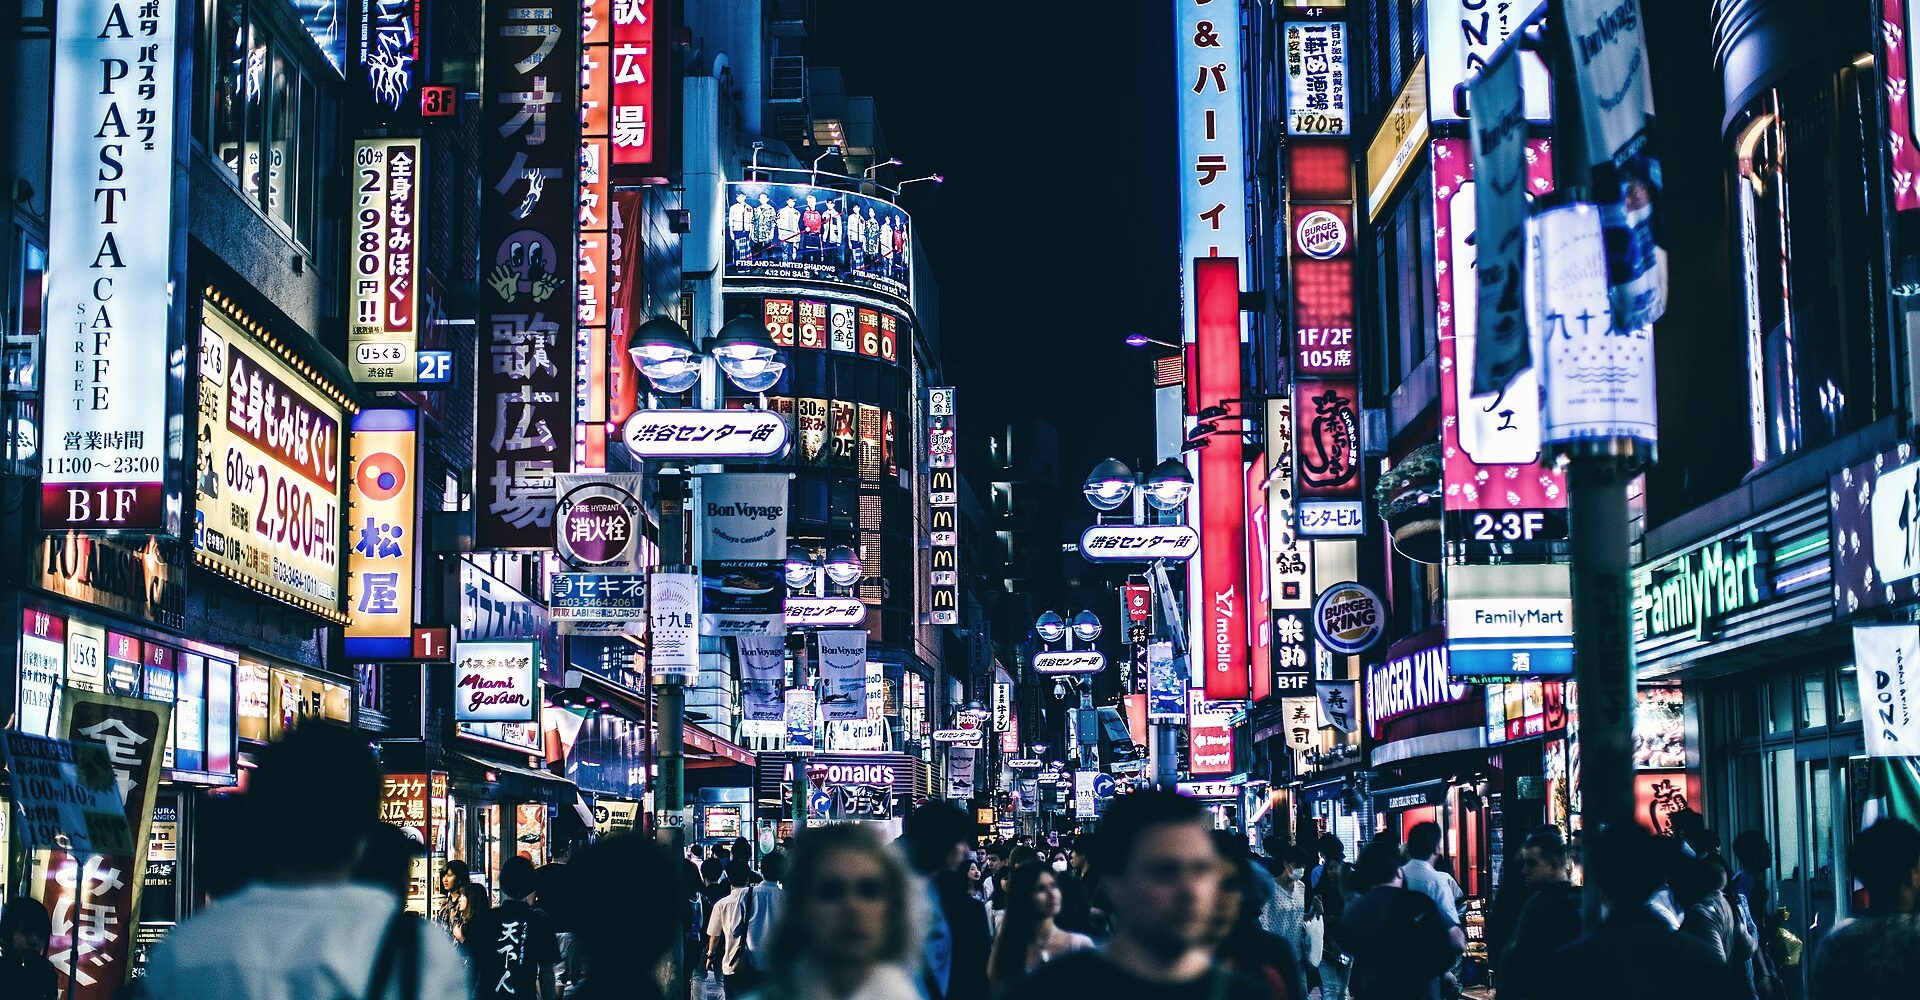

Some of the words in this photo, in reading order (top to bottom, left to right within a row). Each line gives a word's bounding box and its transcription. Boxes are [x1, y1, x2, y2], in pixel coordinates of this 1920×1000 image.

[138, 0, 160, 37] ポタ
[1307, 8, 1323, 17] 4F
[137, 44, 158, 101] パスタ
[426, 90, 453, 113] 3F
[136, 107, 156, 151] カフェ
[1193, 0, 1228, 257] &パーティ
[1296, 114, 1343, 133] 190円
[89, 58, 131, 268] PASTA
[357, 147, 384, 166] 60分
[388, 151, 413, 327] 全身もみほぐし
[1304, 221, 1337, 238] BURGER
[1306, 230, 1339, 249] KING
[736, 260, 769, 268] FTISLAND
[779, 261, 803, 269] UNITED
[803, 263, 836, 273] SHADOWS
[792, 270, 810, 278] SALE
[766, 302, 793, 316] 飲み
[800, 302, 826, 318] 放題
[845, 308, 854, 350] やきとり
[1297, 328, 1352, 347] 1F/2F
[90, 277, 113, 411] CAFFE
[358, 347, 401, 361] りらくる
[72, 303, 86, 411] STREET
[1300, 350, 1351, 368] 105席
[367, 367, 394, 379] 渋谷店
[418, 356, 450, 379] 2F
[229, 357, 337, 480] 全身もみほぐし
[799, 400, 826, 417] 30分
[489, 312, 559, 529] 歌広場
[800, 416, 827, 431] 飲み
[63, 430, 144, 451] 営業時間
[632, 423, 778, 442] 渋谷センター街
[225, 447, 255, 494] 60分
[66, 488, 137, 522] B1F
[575, 504, 589, 513] FIRE
[591, 504, 619, 512] HYDRANT
[707, 502, 735, 517] Bon
[735, 502, 783, 520] Voyage
[1300, 508, 1361, 527] センタービル
[571, 515, 627, 543] 消火栓
[712, 527, 739, 544] Shibuya
[1089, 535, 1192, 549] 渋谷センター街
[355, 515, 403, 615] 松屋
[1640, 532, 1760, 642] FamilyMart
[567, 597, 635, 607] 03-3464-2061
[1325, 599, 1374, 621] BURGER
[552, 608, 570, 618] 買取
[1475, 609, 1564, 626] FamilyMart
[1212, 585, 1234, 673] Y!mobile
[1327, 611, 1376, 636] KING
[420, 632, 445, 656] 1F
[741, 647, 757, 656] Bon
[757, 647, 783, 658] Voyage
[822, 645, 838, 655] Bon
[838, 647, 864, 657] Voyage
[73, 641, 98, 668] りらくる
[1037, 655, 1100, 667] 渋谷センター街
[1512, 652, 1531, 672] 酒
[1137, 644, 1147, 691] AZE
[457, 673, 514, 689] Miami
[1278, 676, 1308, 689] B1F
[1374, 656, 1414, 721] BURGER
[1292, 705, 1310, 744] 寿司
[784, 763, 895, 784] MDonald's
[384, 778, 426, 798] ラオケ
[404, 819, 426, 827] ROOM
[611, 810, 629, 818] MONEY
[495, 921, 520, 994] 天下人
